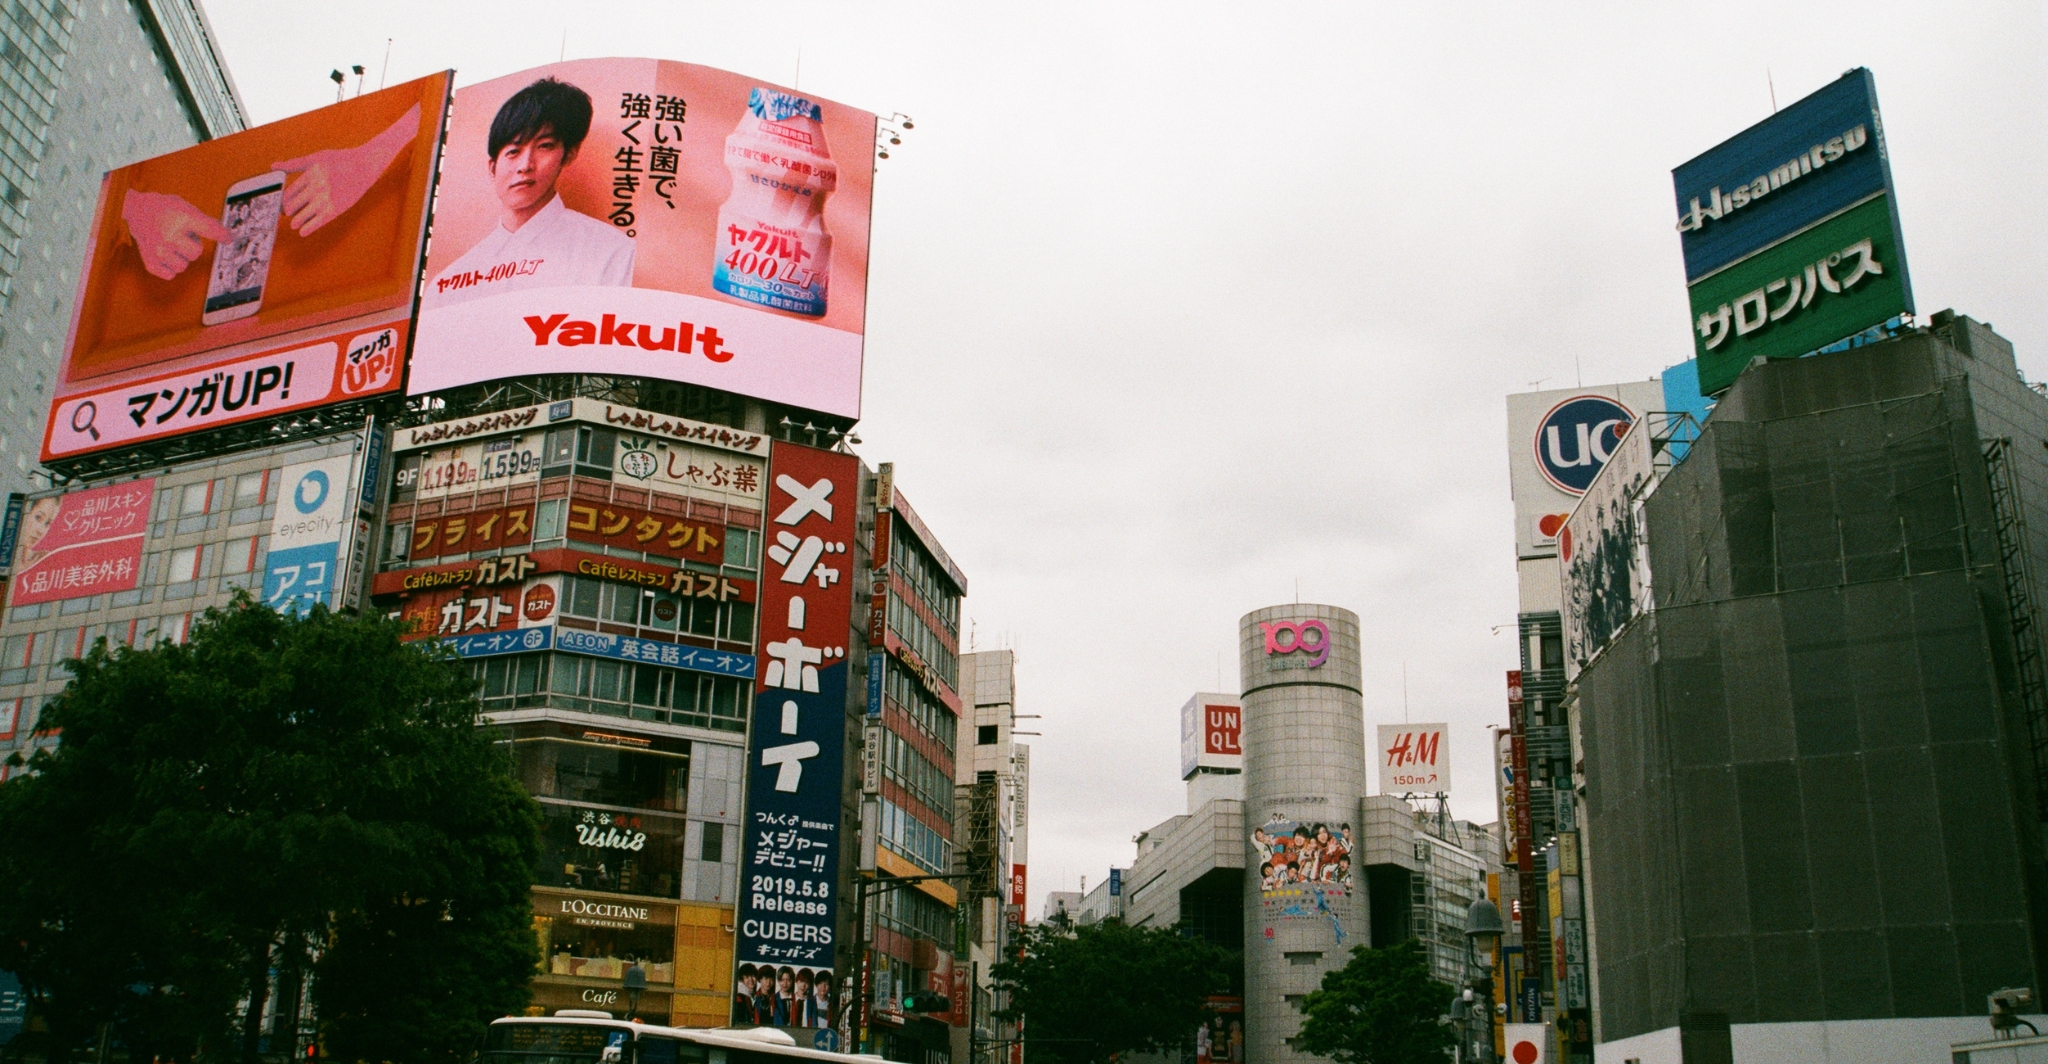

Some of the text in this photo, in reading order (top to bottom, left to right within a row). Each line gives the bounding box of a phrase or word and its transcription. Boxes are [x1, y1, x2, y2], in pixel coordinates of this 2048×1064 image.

[608, 92, 651, 238] 強く生きる。
[648, 94, 687, 210] 強い菌で、
[1676, 123, 1866, 232] Hisamitsu
[728, 224, 811, 262] ヤクルト
[757, 221, 799, 238] Yakult
[1697, 236, 1883, 350] サロンパス
[349, 329, 391, 365] マンガ
[523, 313, 734, 364] Yakult
[344, 347, 394, 392] UP!
[128, 361, 294, 428] マンガUP!
[411, 407, 538, 445] しゃぶしゃぶバイキング
[606, 406, 761, 450] しゃぶしゃぶバイキング
[396, 468, 418, 486] 9F
[667, 451, 758, 493] しゃぶ葉
[82, 491, 147, 516] 品川スキン
[79, 511, 136, 536] クリニック
[280, 517, 334, 537] eyecity
[415, 509, 531, 551] プライス
[569, 505, 721, 552] コンタクト
[31, 557, 133, 592] 品川美容外科
[476, 555, 536, 586] ガスト
[671, 571, 740, 602] ガスト
[439, 595, 513, 635] ガスト
[527, 600, 551, 612] ガスト
[761, 473, 845, 794] メジャーボーイ
[873, 609, 883, 639] ガスト
[565, 633, 751, 673] AEON 英会話イーオン
[1259, 620, 1330, 667] 109
[867, 733, 876, 788] 渋谷駅前ビル
[1387, 732, 1440, 767] H&M
[582, 811, 610, 825] 渋谷
[575, 823, 646, 851] Ushi8
[758, 829, 828, 851] メジャー
[752, 875, 829, 898] 2019.5.8
[1014, 874, 1024, 895] 免税
[752, 893, 827, 915] Release
[957, 904, 965, 925] レイク
[590, 920, 632, 928] PROVENCE
[743, 919, 832, 944] CUBERS
[582, 989, 617, 1006] Café
[1527, 988, 1536, 1021] MIZUHO
